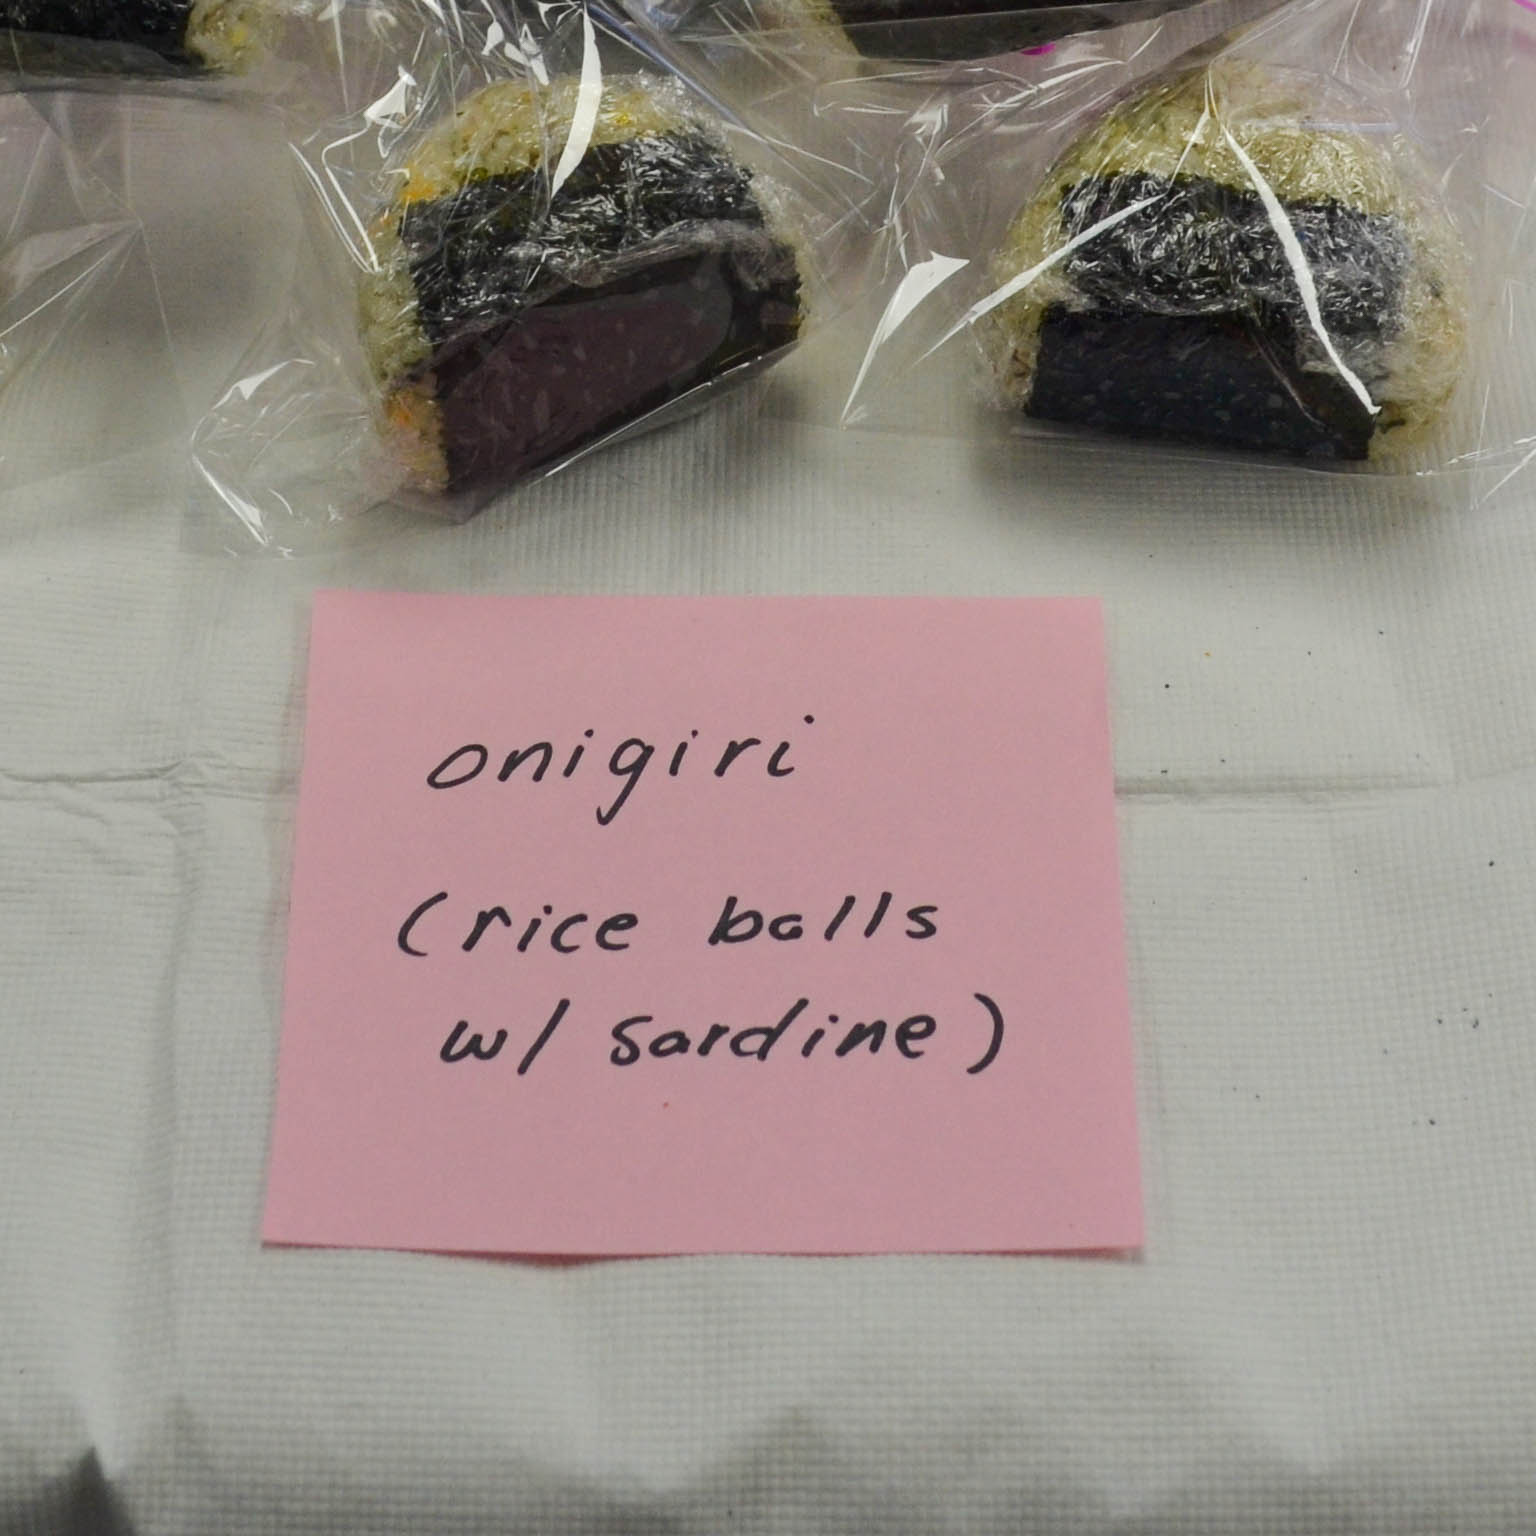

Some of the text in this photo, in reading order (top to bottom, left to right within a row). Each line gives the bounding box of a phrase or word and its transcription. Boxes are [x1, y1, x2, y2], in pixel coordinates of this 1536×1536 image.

[427, 715, 816, 825] onigiri
[398, 891, 940, 956] (rice balls
[440, 999, 571, 1076] w/
